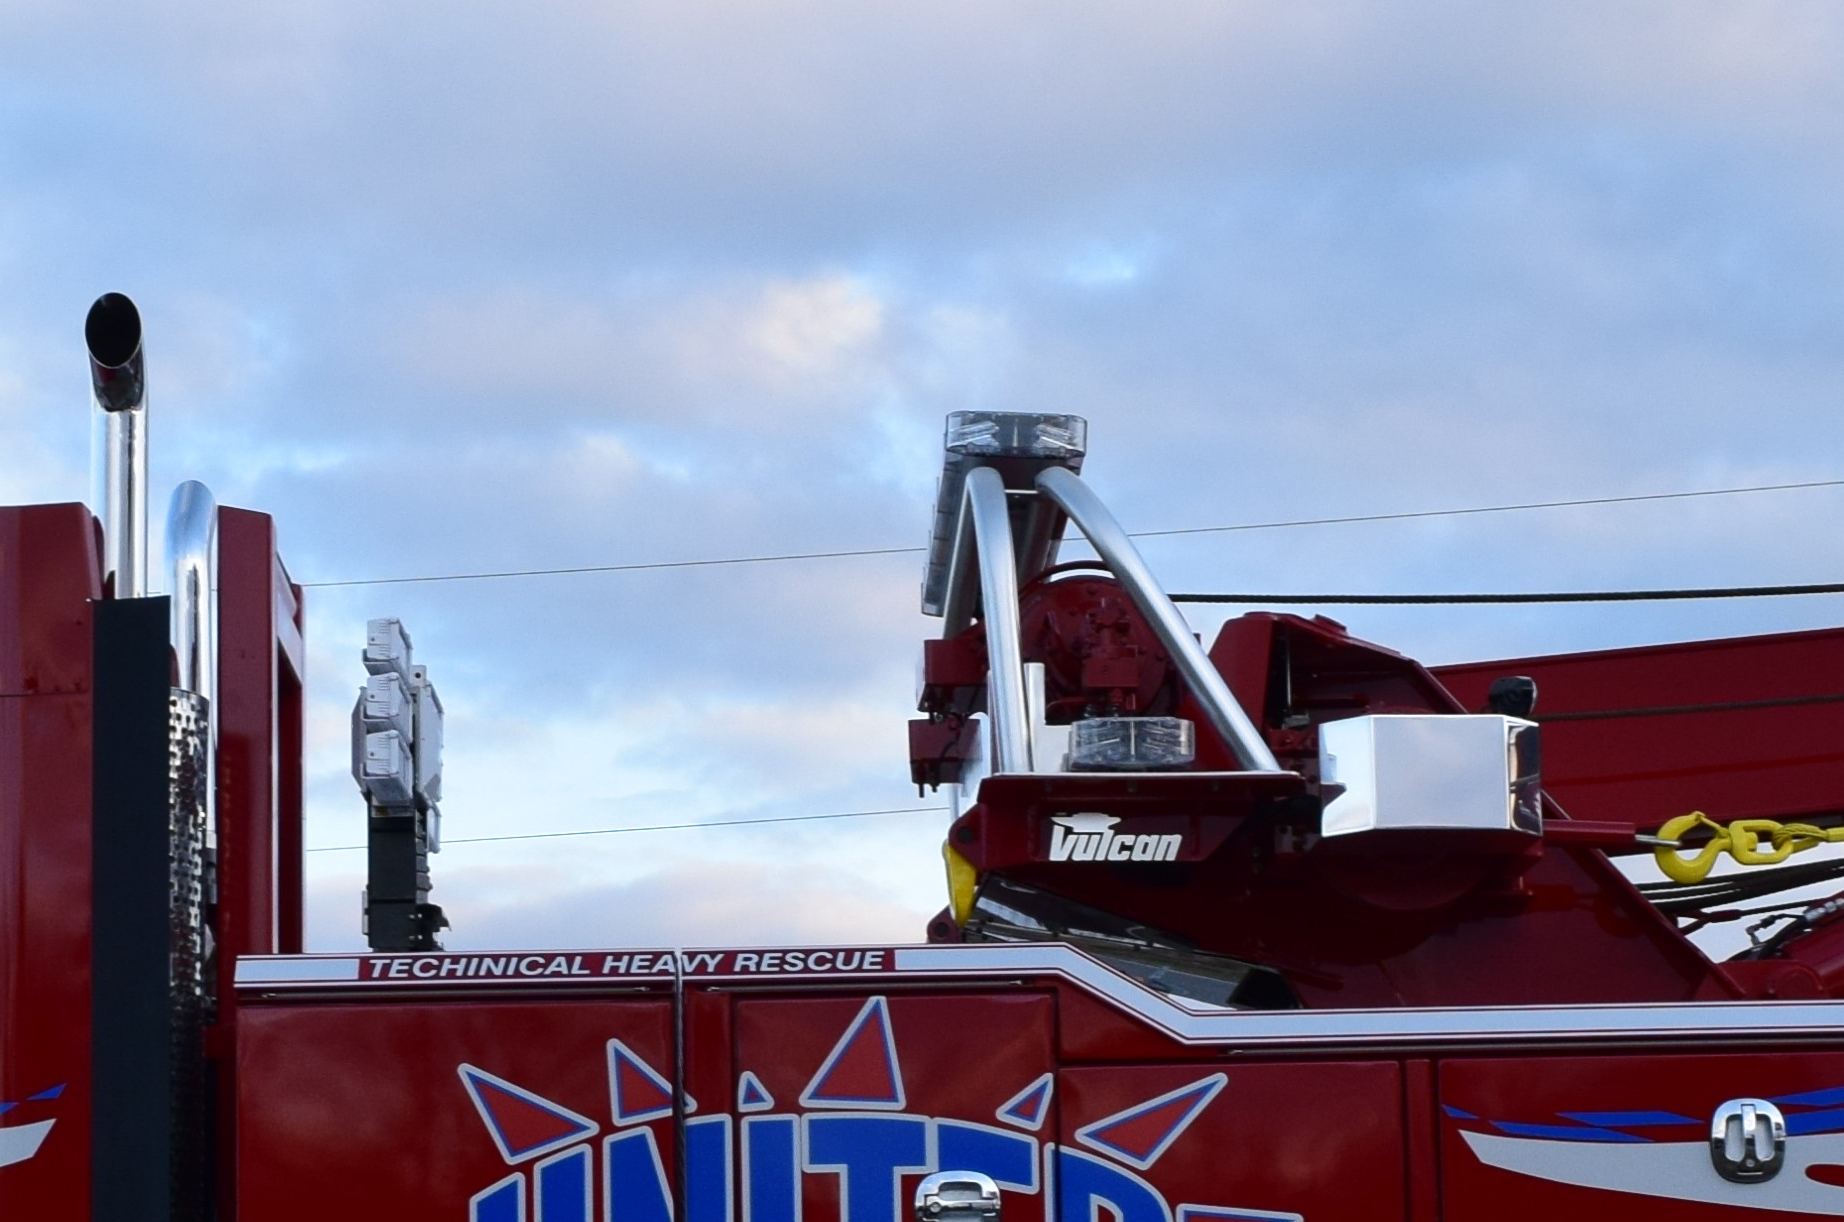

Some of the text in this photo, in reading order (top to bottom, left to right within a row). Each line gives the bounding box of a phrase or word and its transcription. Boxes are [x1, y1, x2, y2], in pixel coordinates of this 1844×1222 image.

[1048, 822, 1183, 862] Vulcan
[368, 951, 885, 979] TECHINICAL HEAVY RESCUE
